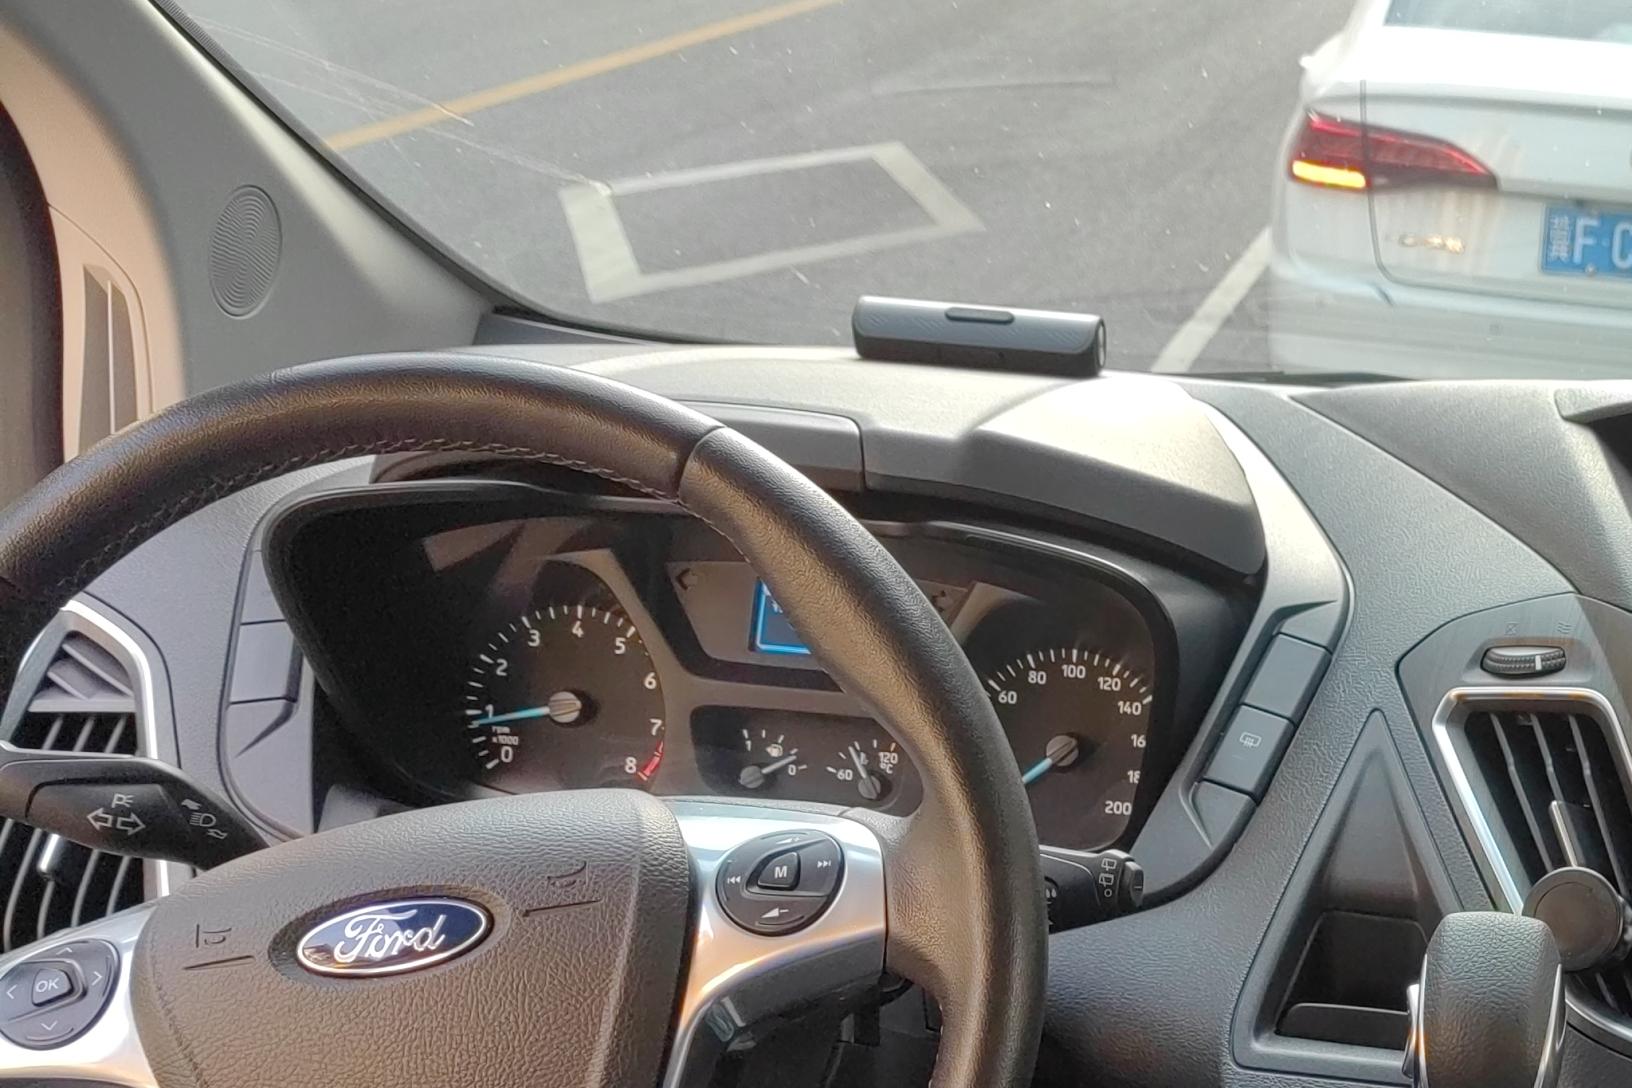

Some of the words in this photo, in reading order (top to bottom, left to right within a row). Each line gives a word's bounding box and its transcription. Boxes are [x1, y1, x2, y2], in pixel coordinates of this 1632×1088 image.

[572, 621, 584, 638] 4
[528, 630, 540, 647] 3
[615, 638, 626, 655] 5
[496, 659, 508, 676] 2
[1061, 664, 1086, 679] 100
[644, 673, 656, 690] 6
[1027, 670, 1047, 685] 80
[1097, 677, 1122, 691] 120
[998, 691, 1018, 704] 60
[1117, 701, 1142, 715] 140
[650, 719, 662, 736] 7
[501, 747, 513, 762] 0
[878, 751, 899, 764] 120
[625, 757, 637, 774] 8
[788, 764, 797, 776] 0
[837, 769, 853, 780] 60
[1104, 801, 1132, 815] 200
[774, 864, 788, 878] M
[334, 909, 447, 962] Ford
[36, 977, 60, 993] OK
